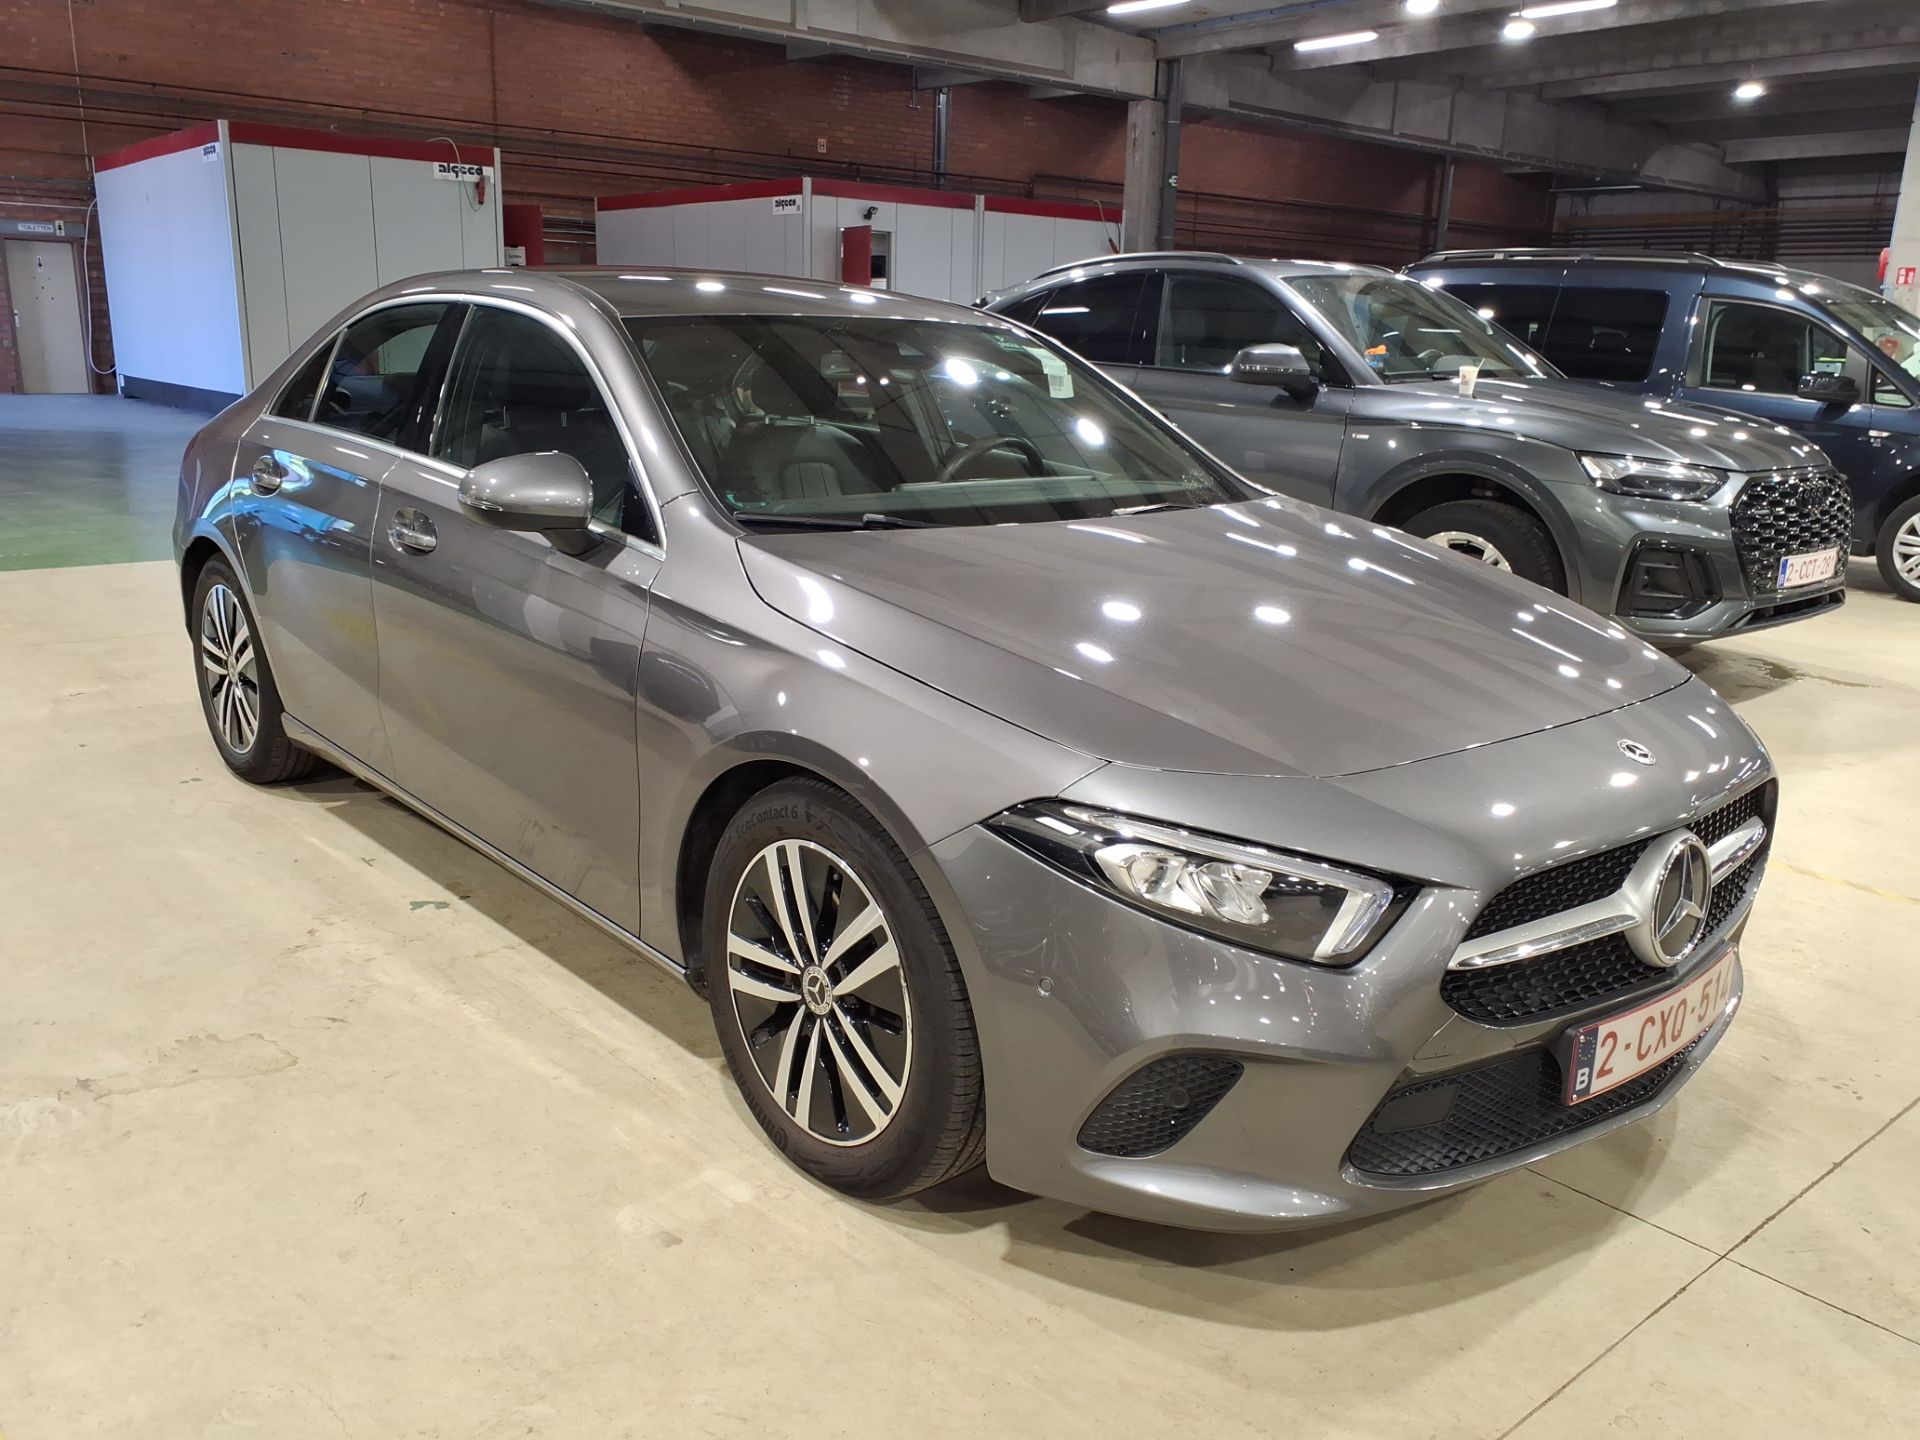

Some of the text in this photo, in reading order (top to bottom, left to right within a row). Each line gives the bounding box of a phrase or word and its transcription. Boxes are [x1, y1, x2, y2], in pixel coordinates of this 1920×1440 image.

[735, 804, 799, 840] EcoContact 6
[1575, 1067, 1589, 1091] B
